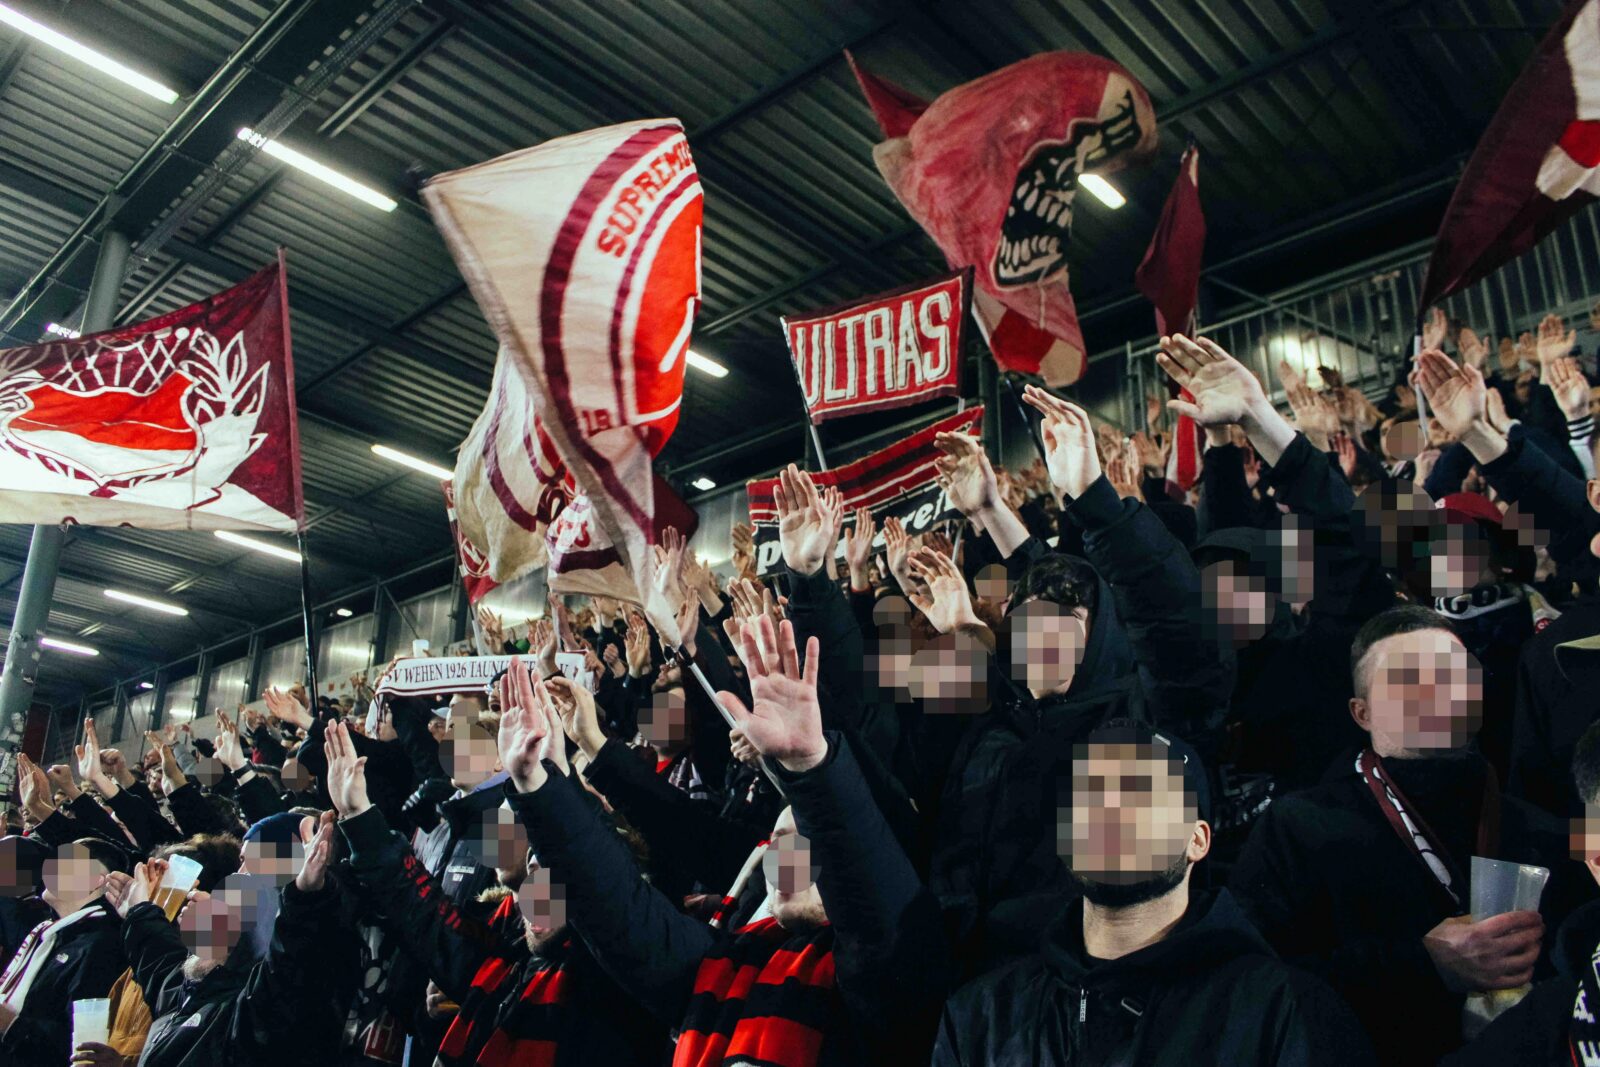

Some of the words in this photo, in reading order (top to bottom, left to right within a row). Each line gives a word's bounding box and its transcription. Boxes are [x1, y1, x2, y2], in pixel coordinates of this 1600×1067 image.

[796, 290, 951, 407] ULTRAS
[403, 664, 442, 683] WEHEN
[446, 662, 467, 679] 1926
